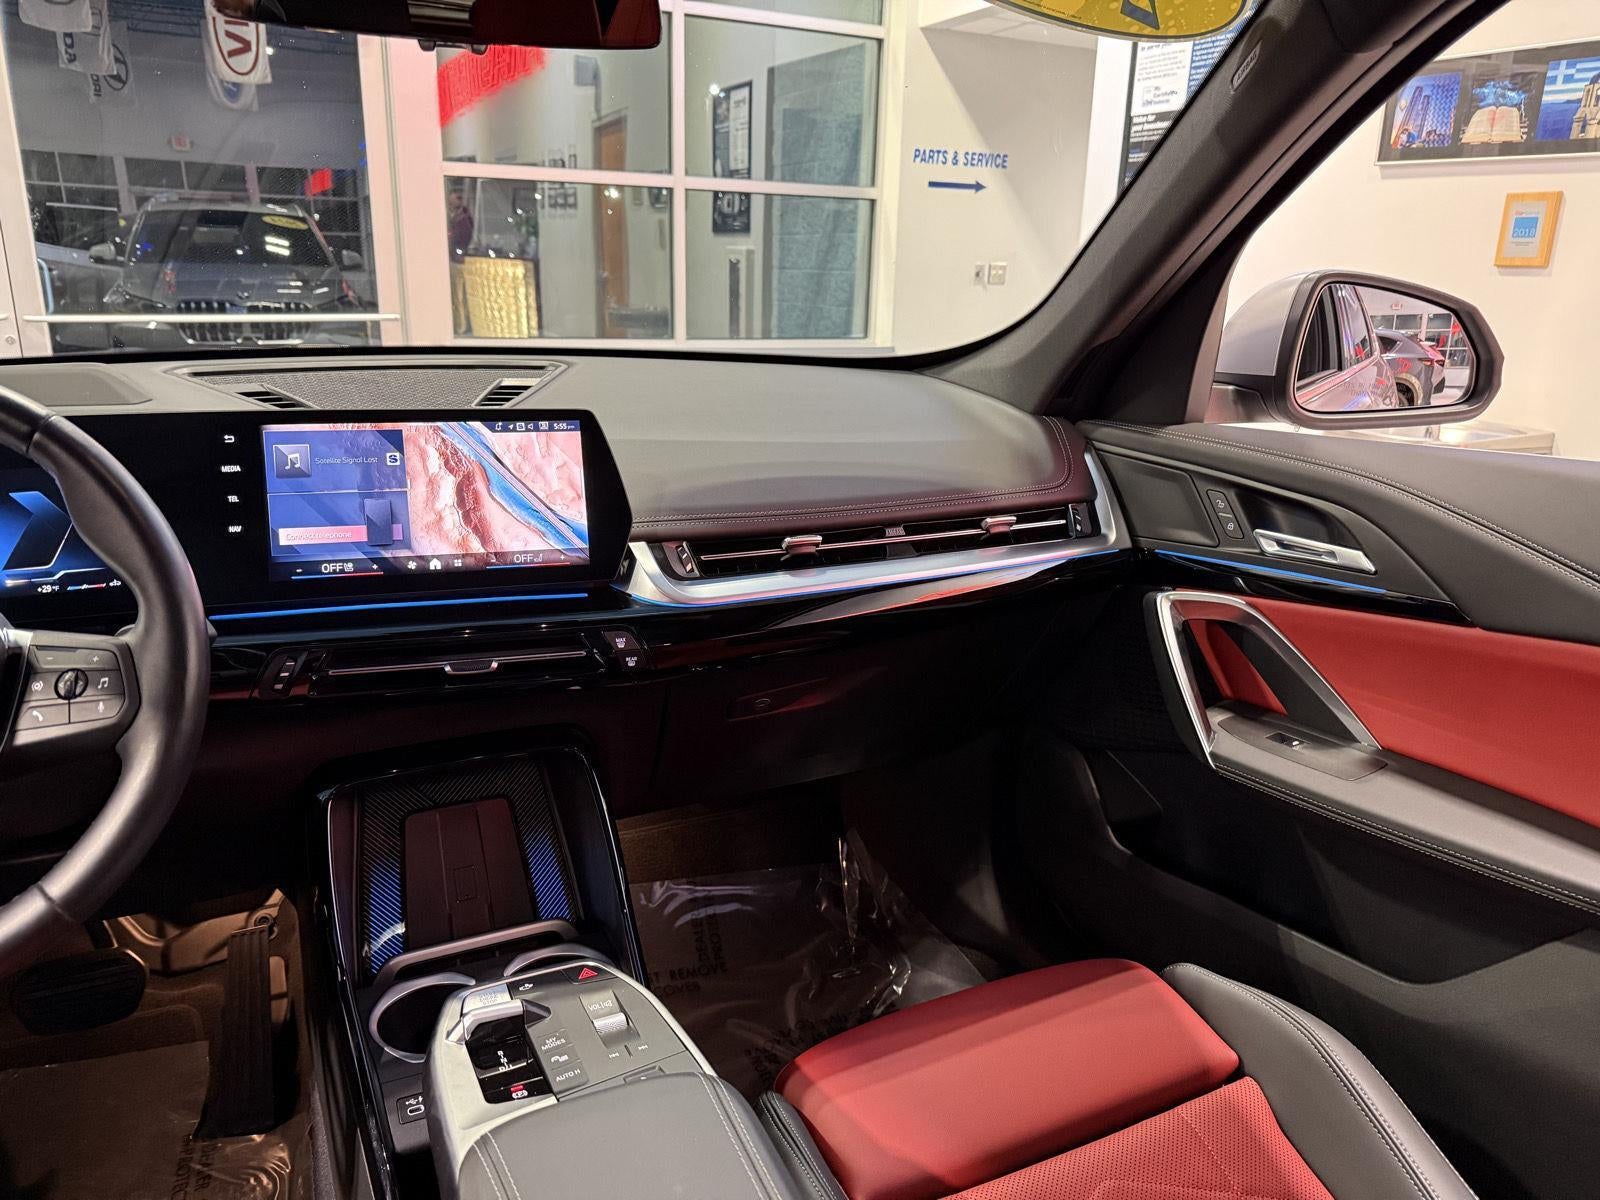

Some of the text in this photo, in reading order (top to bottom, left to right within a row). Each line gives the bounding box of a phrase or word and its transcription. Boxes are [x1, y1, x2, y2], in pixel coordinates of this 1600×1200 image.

[224, 19, 252, 59] IA
[913, 148, 1009, 170] PARTS & SERVICE
[553, 422, 568, 430] 5:55
[315, 455, 379, 466] Satellite Signal Lost
[221, 464, 242, 473] MEDIA
[227, 495, 240, 503] TEL
[228, 524, 242, 534] NAV
[514, 554, 534, 564] OFF
[321, 563, 343, 573] OFF
[541, 1038, 566, 1050] MODES
[545, 1036, 557, 1044] MY
[555, 1068, 582, 1082] AUTO H
